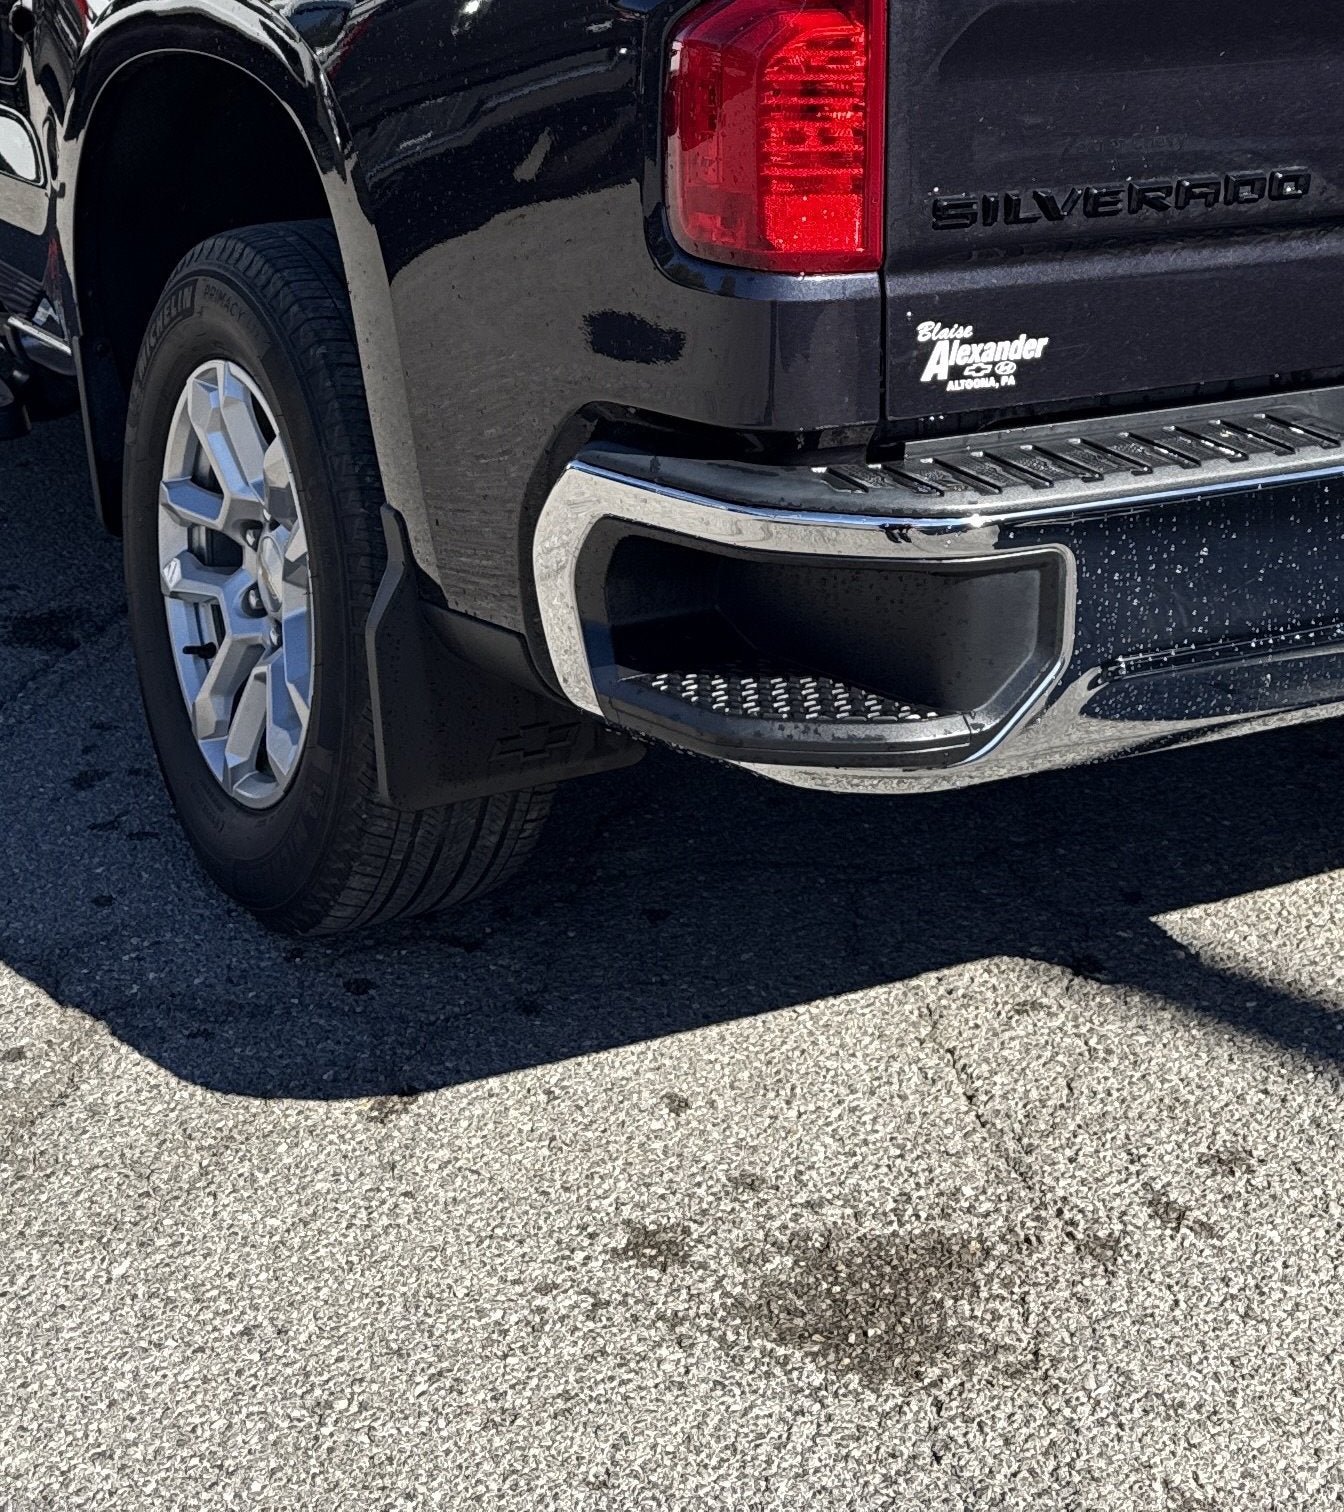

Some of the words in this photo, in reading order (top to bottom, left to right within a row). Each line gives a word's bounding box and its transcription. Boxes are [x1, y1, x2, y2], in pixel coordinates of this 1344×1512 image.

[931, 165, 1312, 230] SILVERADO
[916, 320, 974, 342] Blaise
[920, 333, 1050, 382] Alexander
[1001, 375, 1016, 387] PA
